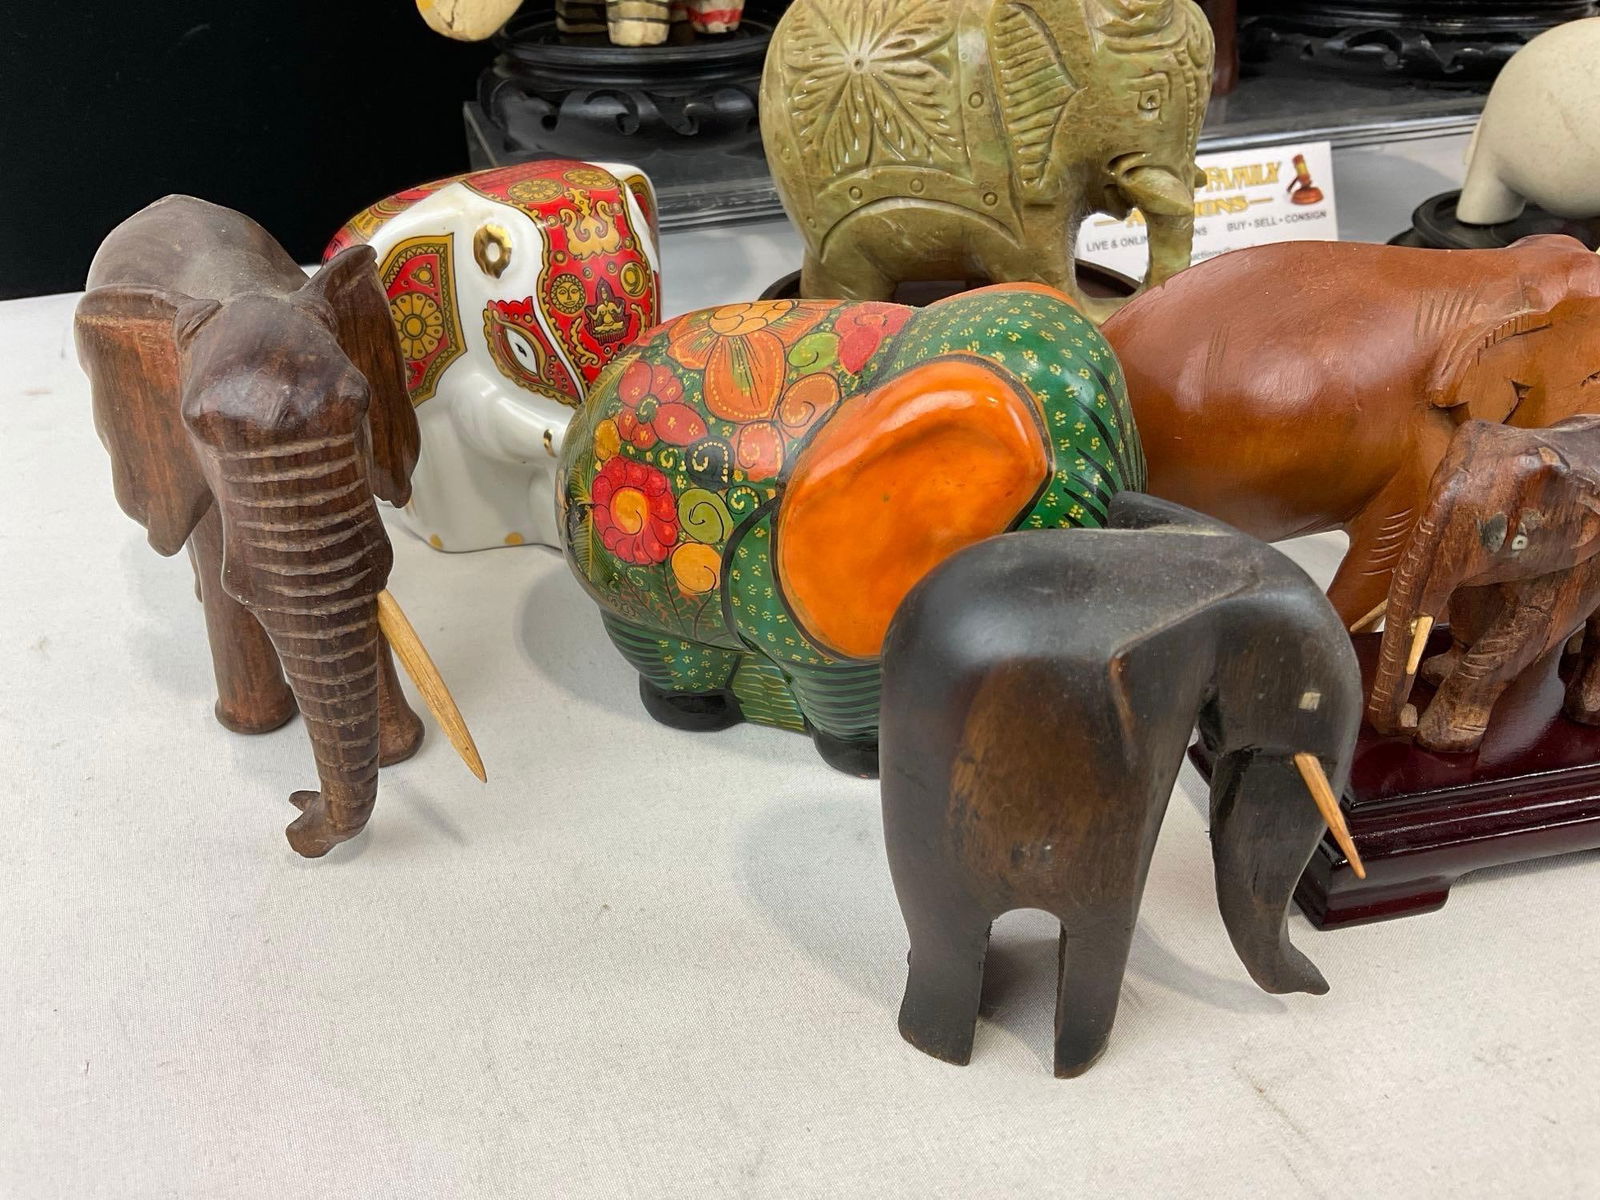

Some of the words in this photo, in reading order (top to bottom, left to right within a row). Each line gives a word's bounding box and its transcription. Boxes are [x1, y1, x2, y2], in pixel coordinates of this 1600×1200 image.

[1206, 161, 1282, 192] FAMILY
[1227, 220, 1247, 232] BUY
[1254, 216, 1278, 228] SELL
[1284, 210, 1327, 225] CONSIGN
[1086, 240, 1109, 252] LIVE
[1111, 239, 1118, 249] &
